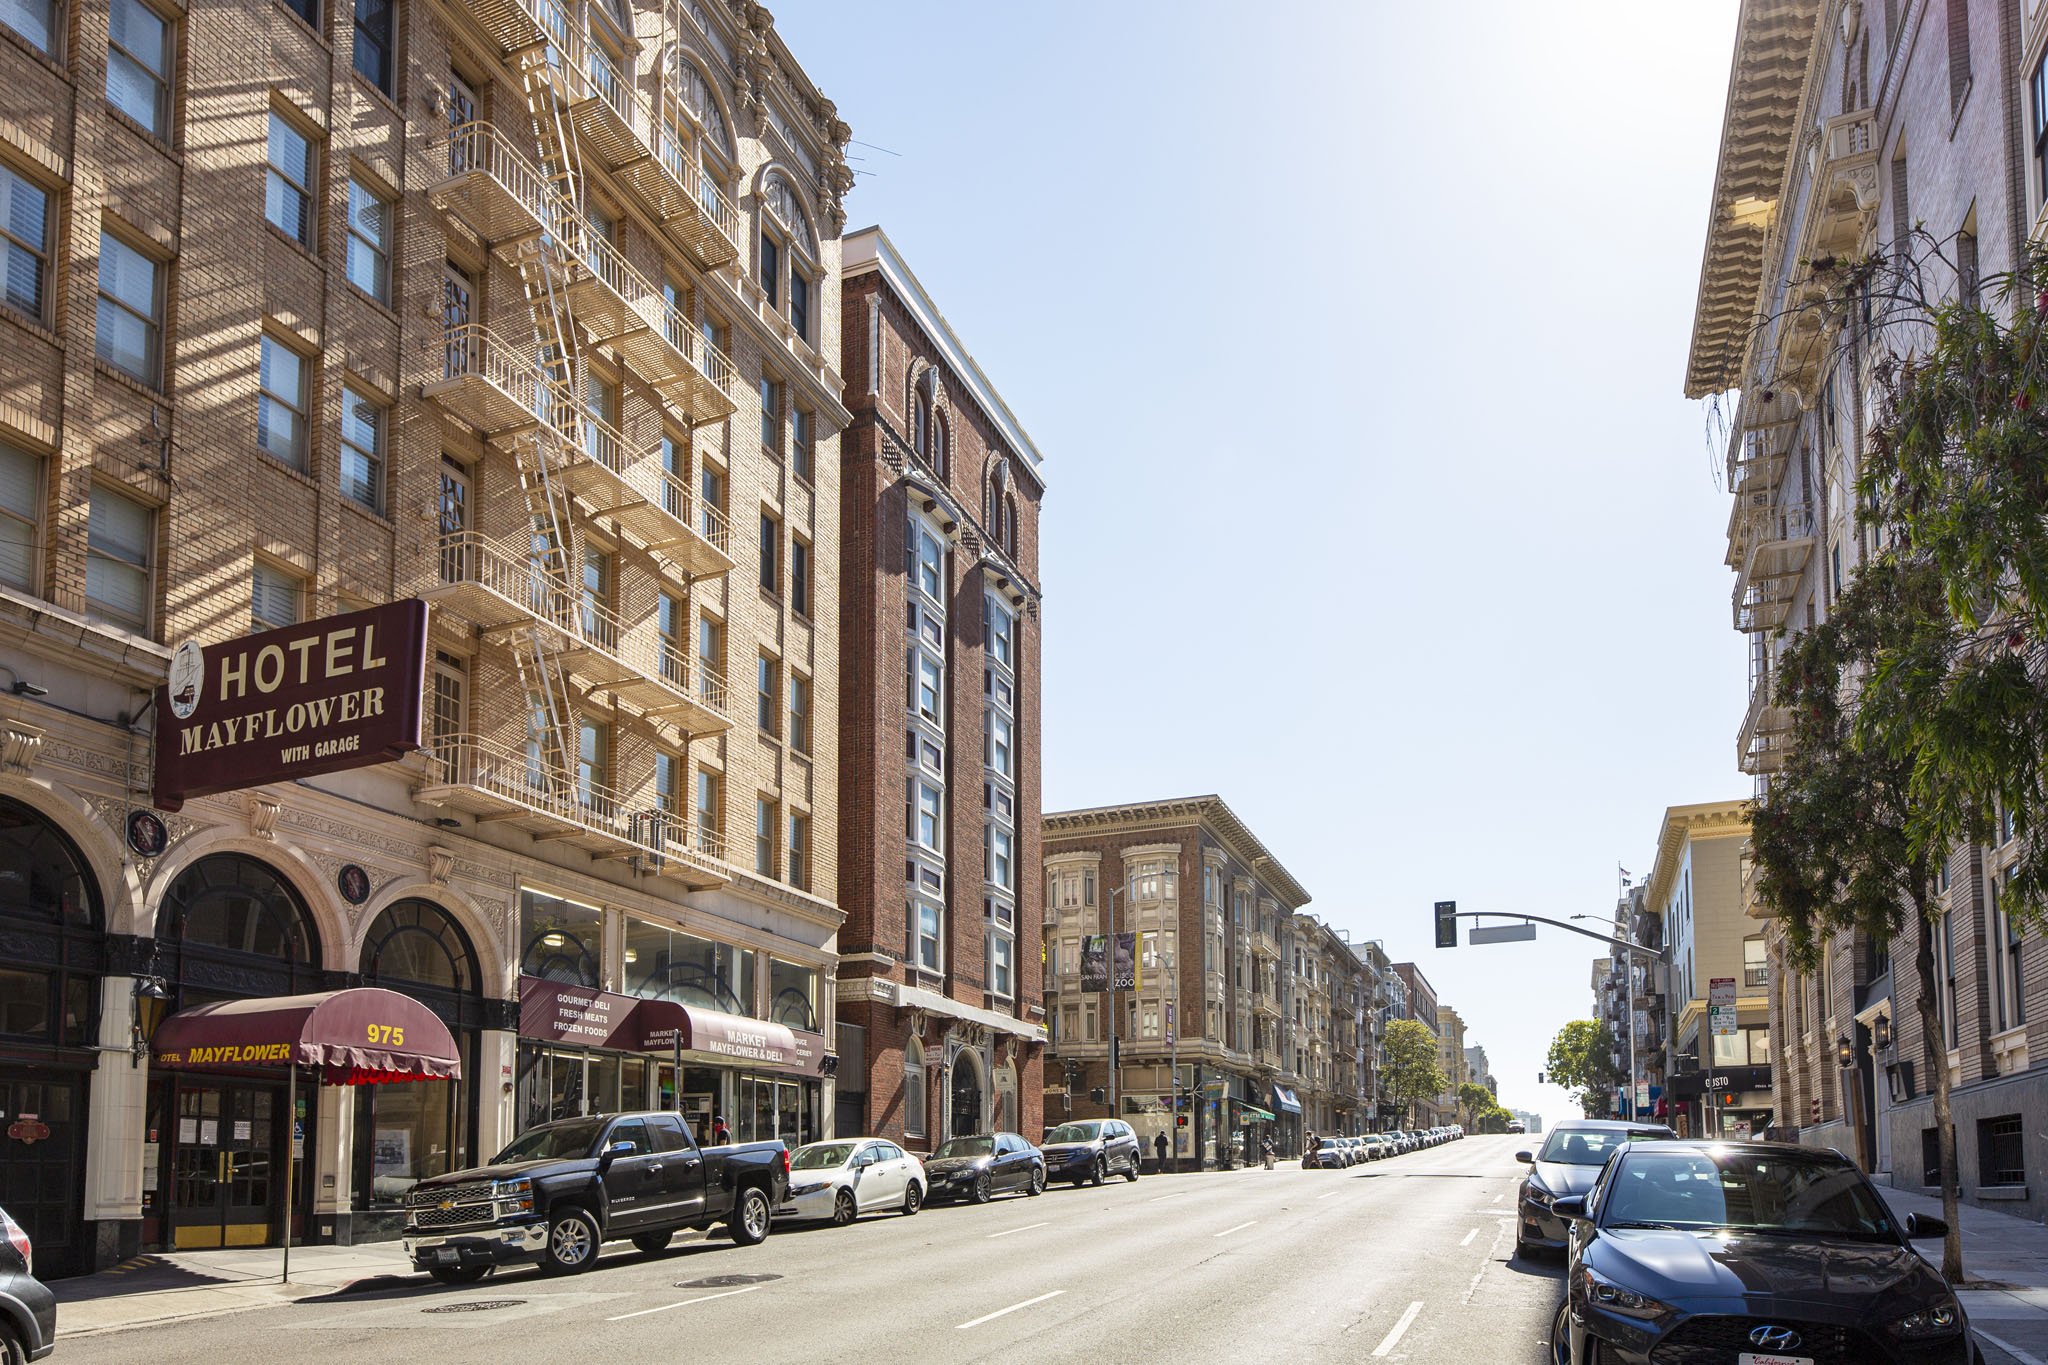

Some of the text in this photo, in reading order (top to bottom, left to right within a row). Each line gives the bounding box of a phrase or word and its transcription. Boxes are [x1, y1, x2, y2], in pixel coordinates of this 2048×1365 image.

[220, 625, 386, 701] HOTEL
[180, 687, 385, 756] MAYFLOWER
[281, 735, 360, 764] WITH GARAGE
[1115, 979, 1135, 987] ZOO
[557, 994, 610, 1011] GOURMET DELI
[559, 1008, 608, 1024] FRESH MEATS
[367, 1023, 404, 1046] 975
[553, 1021, 608, 1037] FROZEN FOODS
[650, 1030, 677, 1038] MARKE
[644, 1037, 684, 1046] MAYFLOWR
[727, 1030, 766, 1048] MARKET
[188, 1043, 290, 1063] MAYFLOWER
[710, 1041, 783, 1062] MAYFLOWER & DELI
[1705, 1076, 1728, 1088] GUSTO
